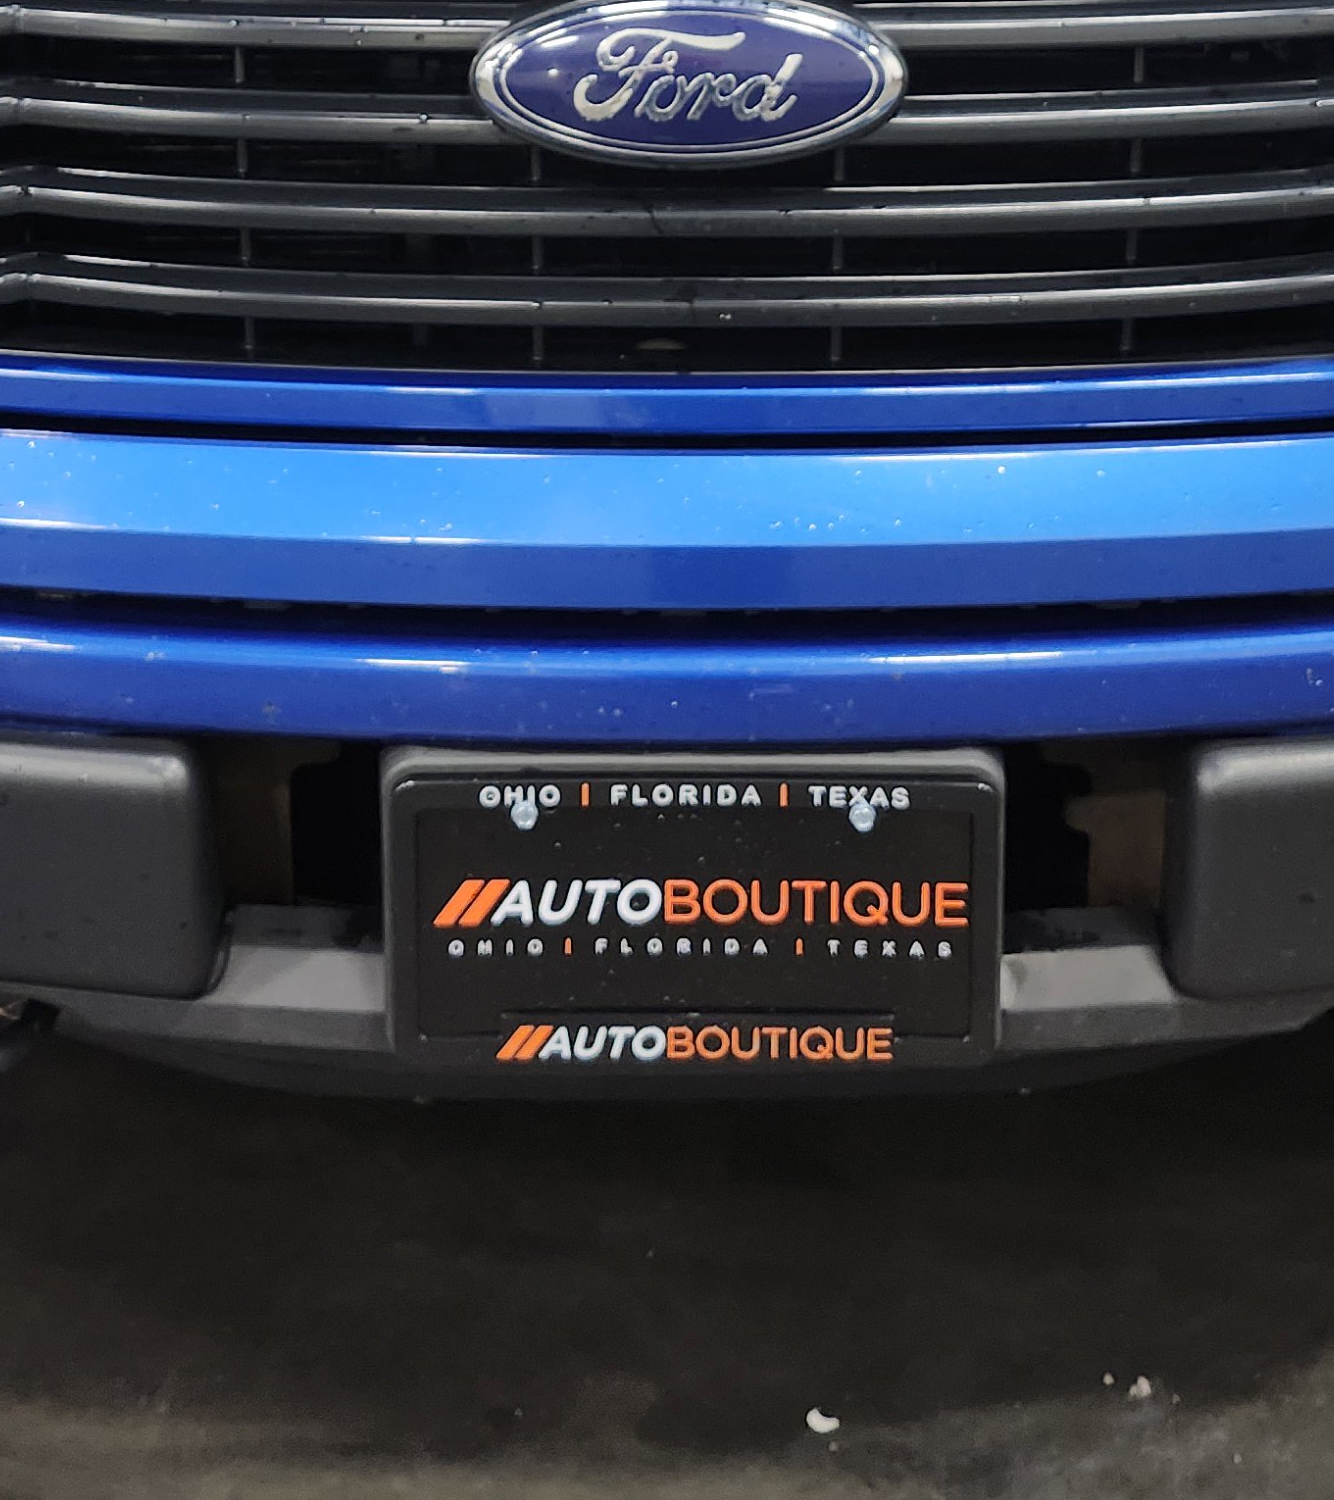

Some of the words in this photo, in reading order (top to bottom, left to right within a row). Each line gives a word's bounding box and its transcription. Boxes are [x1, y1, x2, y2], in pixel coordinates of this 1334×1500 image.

[572, 26, 805, 123] Ford
[478, 784, 562, 809] OHIO
[609, 783, 763, 808] FLORIDA
[808, 784, 911, 809] TEXAS
[490, 877, 971, 928] AUTOBOUTIQUE
[448, 937, 545, 957] OHIO
[594, 936, 770, 957] FLORIDA
[826, 937, 954, 959] TEXAS
[537, 1024, 895, 1062] AUTOBOUTIQUE
